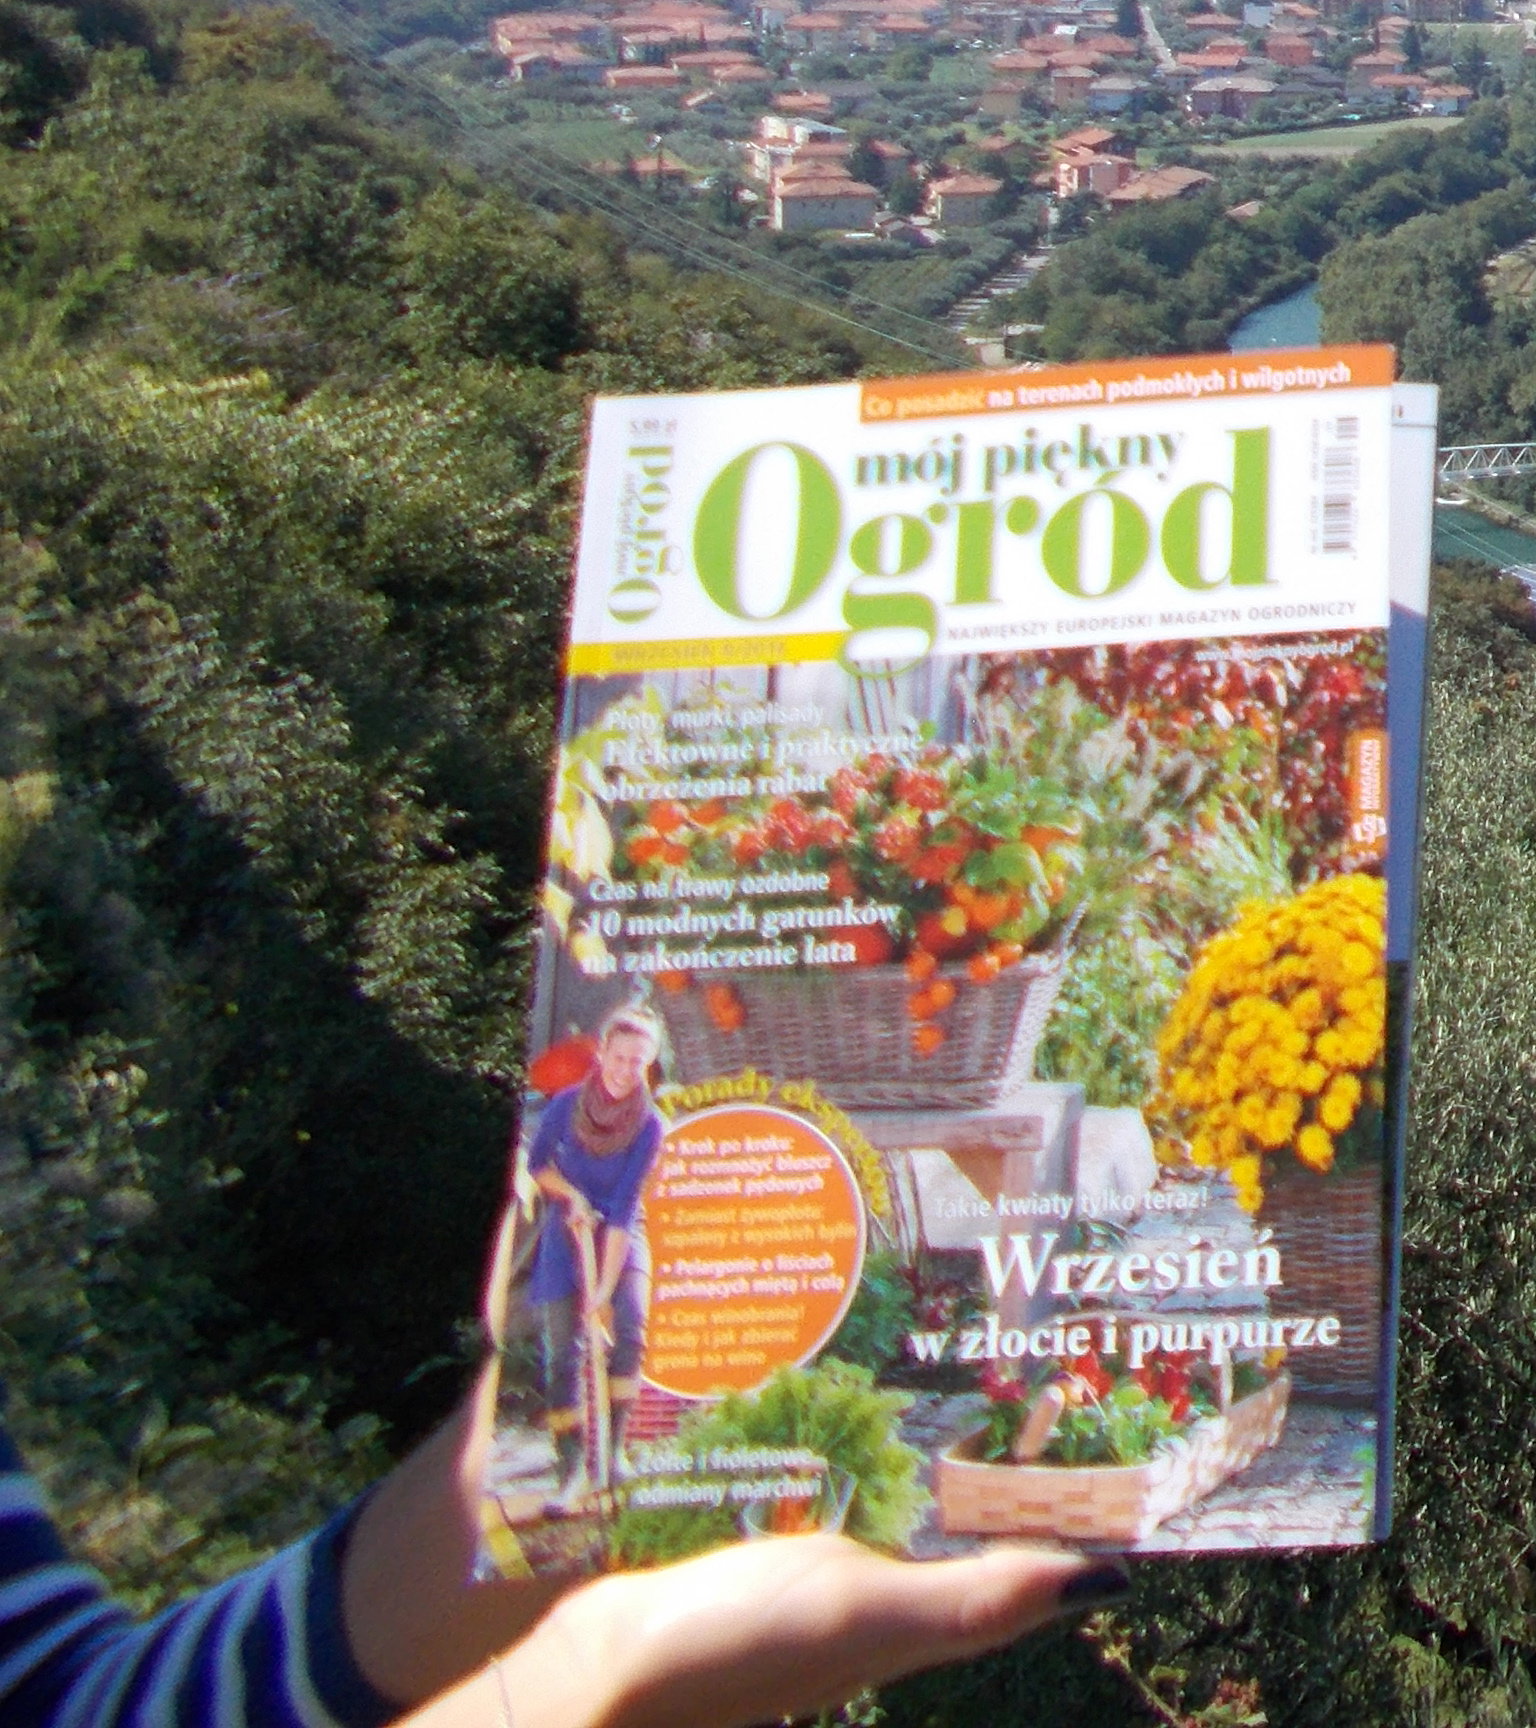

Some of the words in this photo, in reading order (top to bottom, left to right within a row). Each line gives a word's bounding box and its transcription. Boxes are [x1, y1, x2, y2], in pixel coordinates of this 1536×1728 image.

[988, 391, 1014, 408] na
[1017, 379, 1103, 405] terenach
[1106, 370, 1225, 402] podmokłych
[1229, 369, 1237, 389] i
[1241, 362, 1351, 391] wilgotnych
[855, 432, 964, 494] mój
[983, 424, 1184, 492] piękny
[692, 425, 1279, 680] Ogród
[1056, 615, 1152, 634] EUROPEJSKI
[1160, 608, 1241, 626] MAGAZYN
[1248, 601, 1357, 621] OGRODNICZY
[760, 737, 770, 760] i
[590, 879, 637, 901] Czas
[642, 881, 669, 899] na
[673, 876, 735, 901] trawy
[740, 872, 829, 894] ozdobne
[589, 912, 621, 937] 10
[626, 903, 755, 942] modnych
[762, 896, 901, 939] gatunków
[582, 951, 618, 973] na
[624, 939, 798, 972] zakończenie
[804, 936, 857, 963] lata
[718, 1141, 741, 1157] po
[936, 1196, 991, 1219] Takie
[998, 1193, 1073, 1221] kwiaty
[1078, 1190, 1136, 1216] tylko
[1143, 1190, 1208, 1212] teraz!
[980, 1227, 1284, 1299] Wrzesień
[909, 1330, 951, 1362] w
[957, 1314, 1092, 1360] złocie
[1103, 1315, 1118, 1355] i
[1129, 1316, 1341, 1373] purpurze
